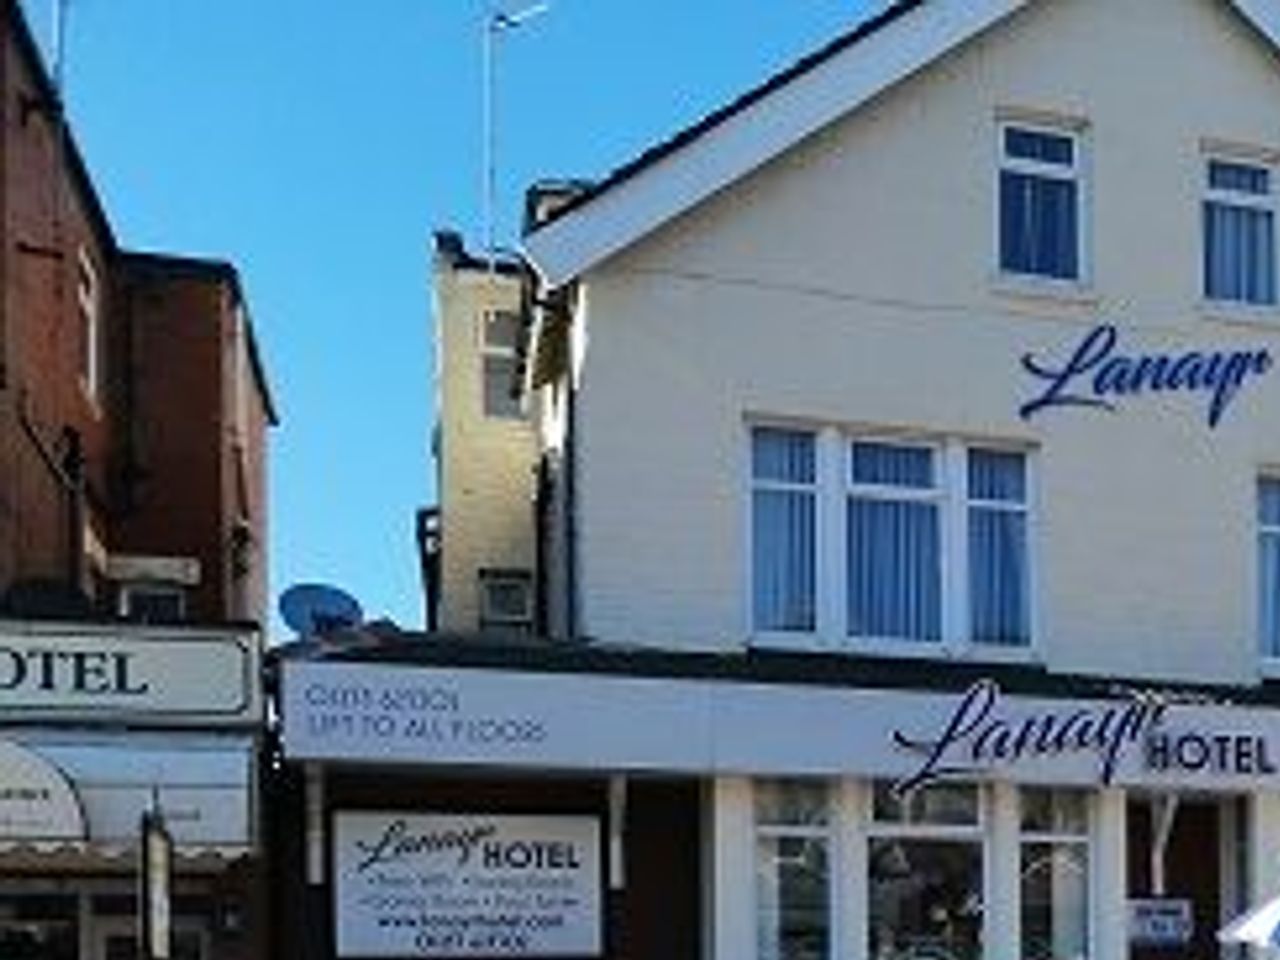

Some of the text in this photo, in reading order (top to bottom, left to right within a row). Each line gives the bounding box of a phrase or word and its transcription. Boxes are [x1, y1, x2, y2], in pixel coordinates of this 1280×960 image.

[1019, 323, 1273, 428] Lanayr
[893, 680, 1278, 798] Lanayr HOTEL
[483, 841, 581, 870] HOTEL
